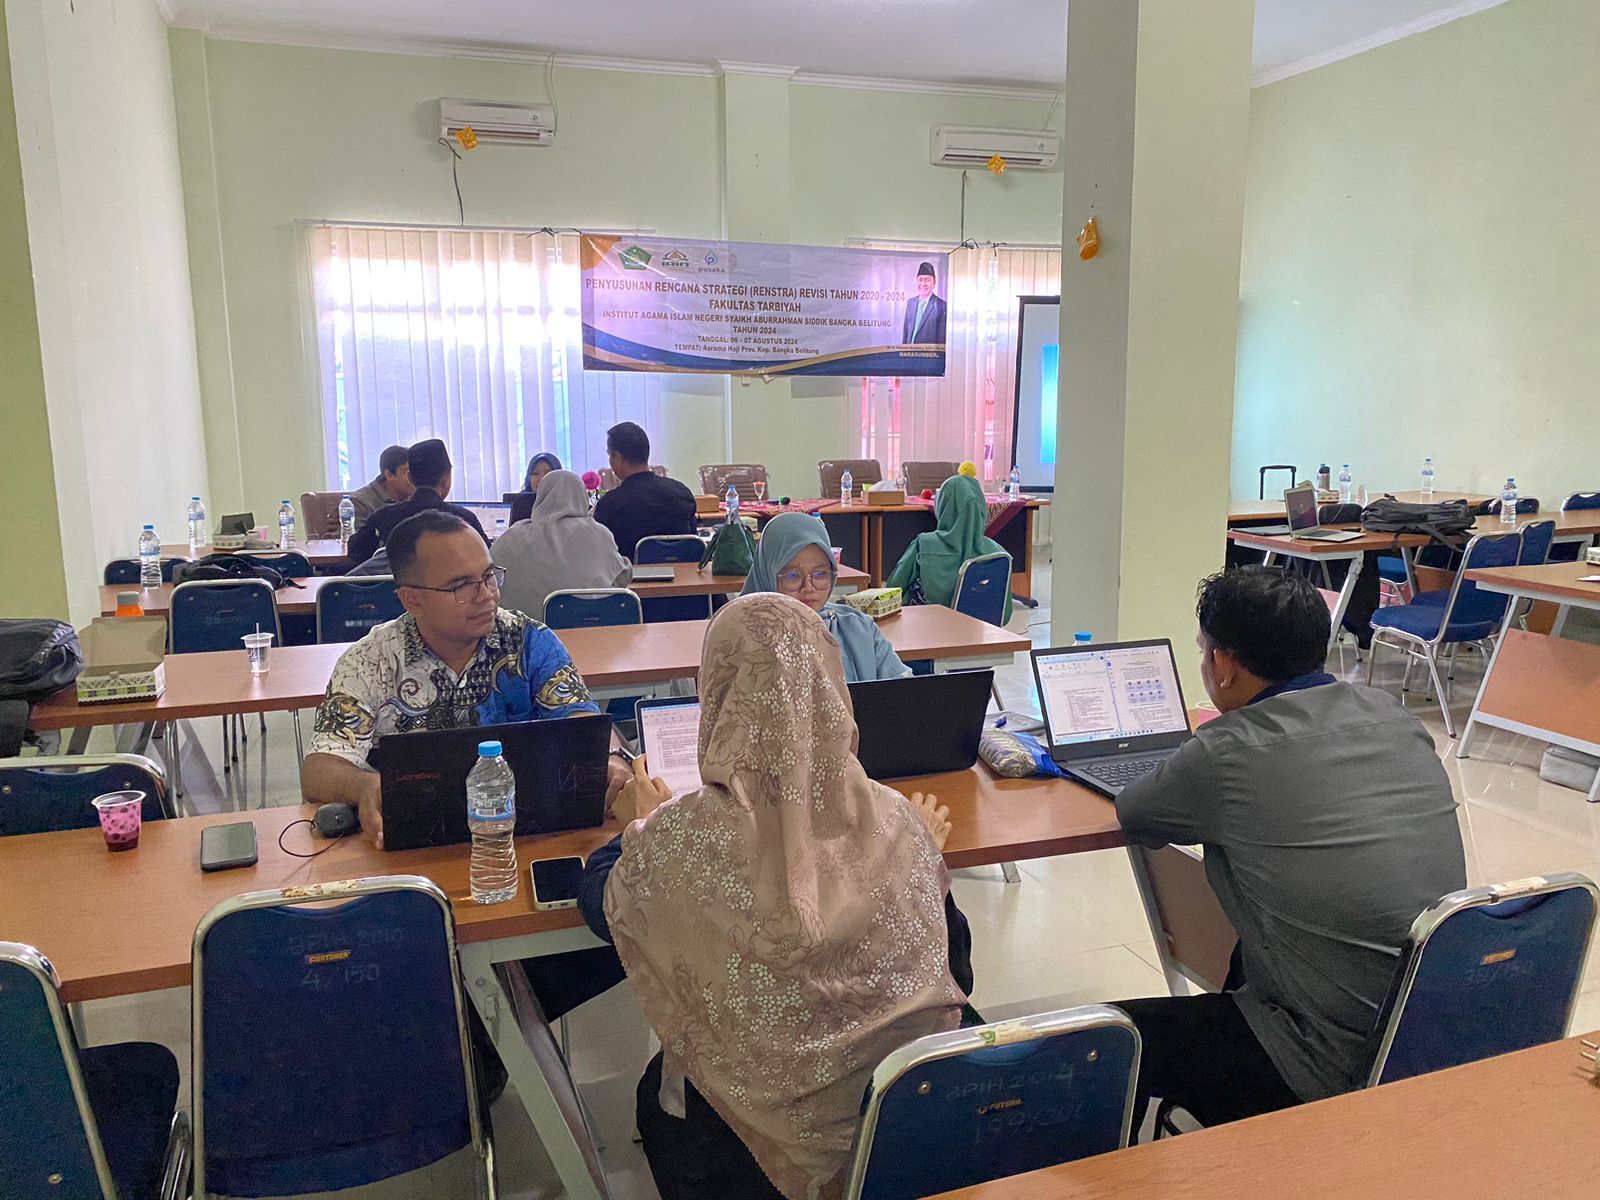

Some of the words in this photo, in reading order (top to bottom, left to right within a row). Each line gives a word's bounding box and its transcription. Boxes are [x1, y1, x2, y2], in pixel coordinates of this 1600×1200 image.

[585, 278, 652, 291] PENYUSUNAN
[654, 281, 700, 294] RENCANA
[702, 283, 747, 296] STRATEGI
[749, 286, 797, 300] (RENSTRA)
[799, 288, 828, 299] REVISI
[829, 289, 859, 300] TAHUN
[860, 290, 880, 301] 2020
[885, 291, 905, 302] 2024
[709, 299, 755, 311] FAKULTAS
[757, 301, 801, 312] TARBIYAH
[602, 310, 639, 318] INSTITUT
[641, 311, 668, 320] AGAMA
[670, 312, 693, 320] ISLAM
[694, 313, 723, 322] NEGERI
[724, 315, 752, 323] SYAIKH
[804, 318, 828, 326] SIDDIK
[829, 319, 857, 327] BANGKA
[858, 319, 892, 328] BELITUNG
[733, 326, 758, 334] TAHUN
[759, 327, 777, 335] 2024
[697, 335, 729, 343] TANGGAL:
[752, 337, 783, 345] AGUSTUS
[674, 343, 702, 351] TEMPAT:
[795, 347, 820, 355] Belitung
